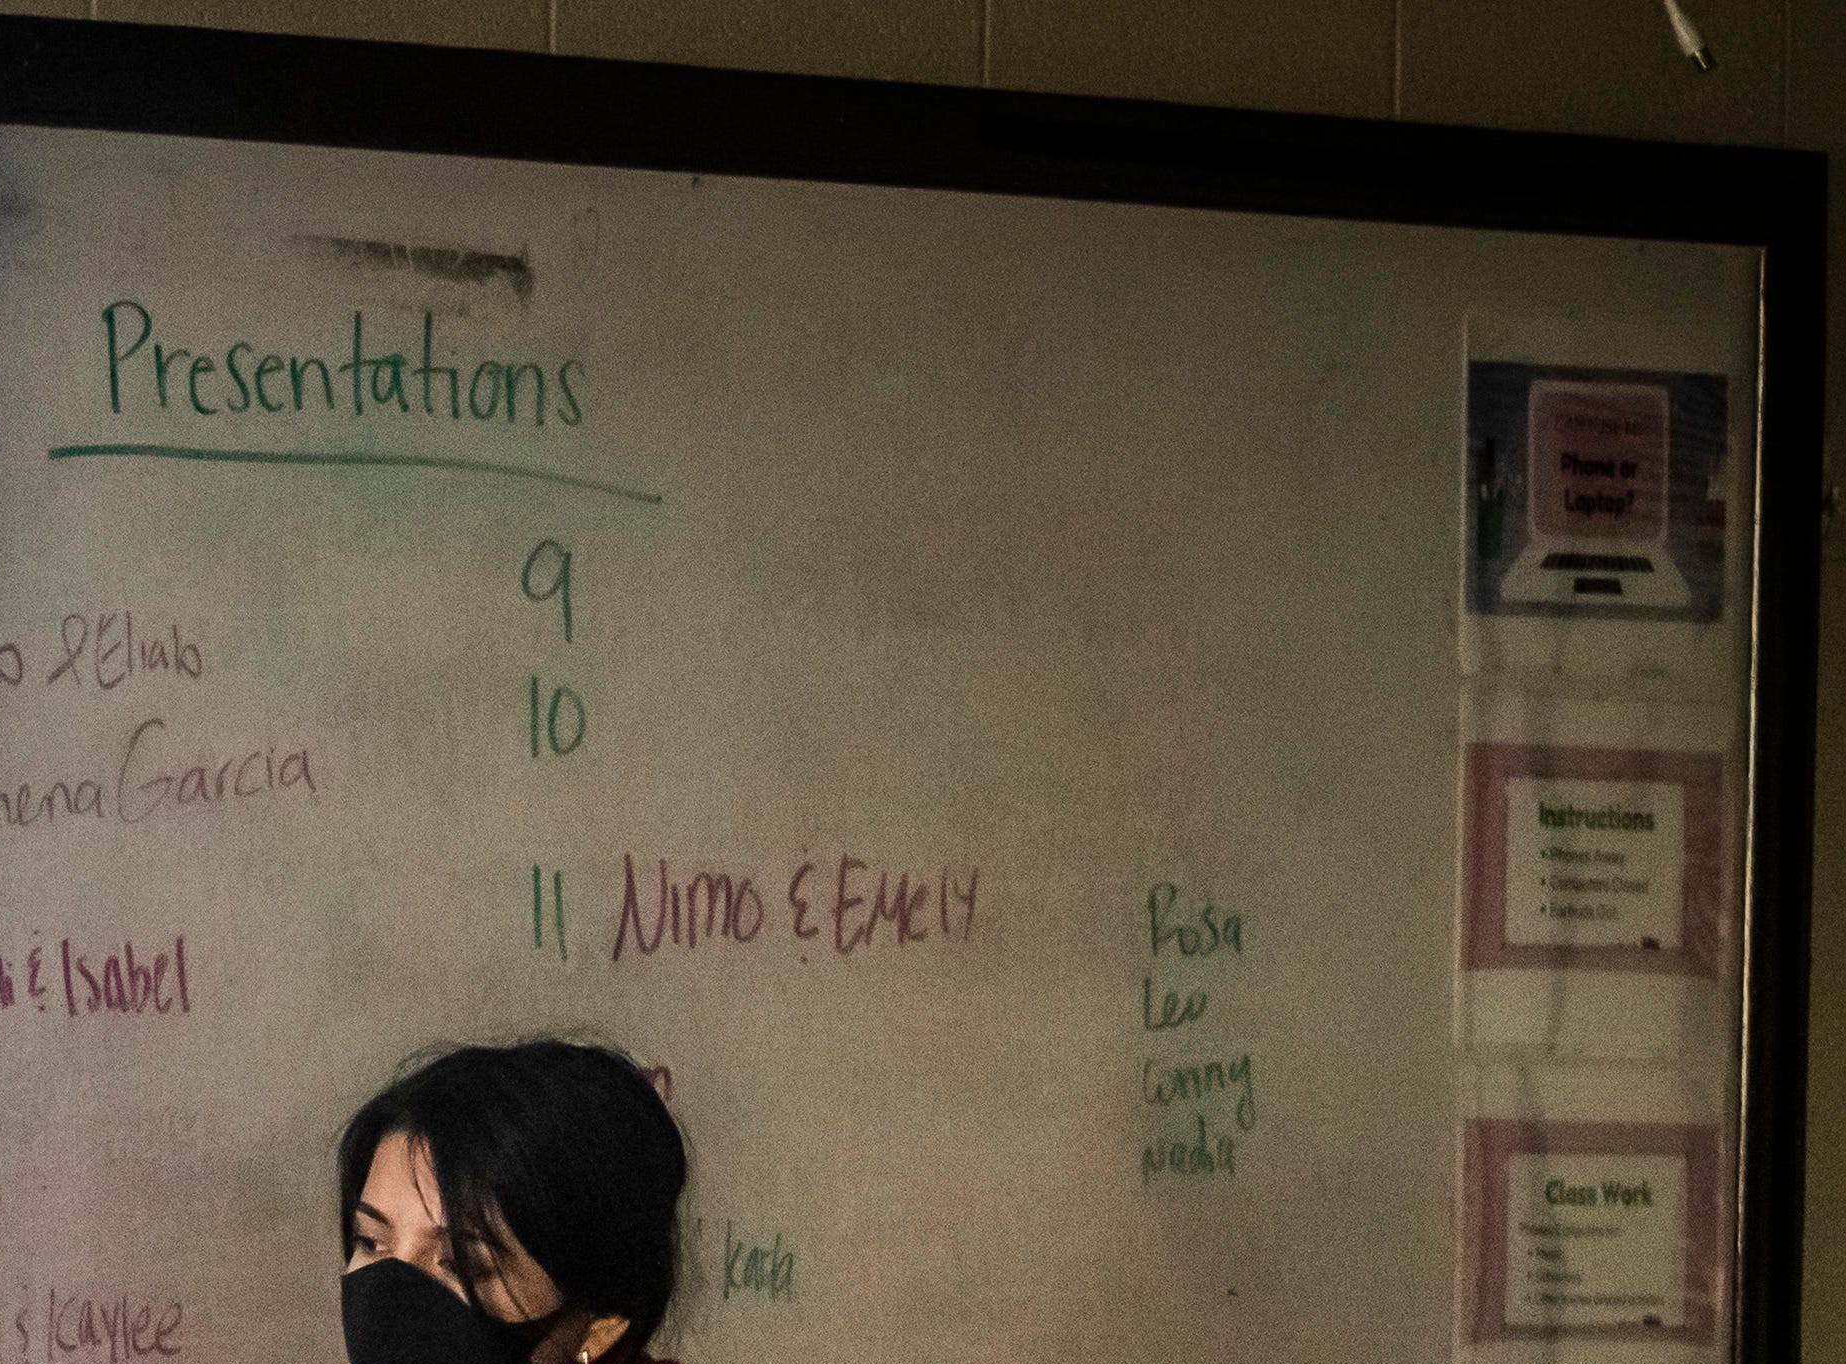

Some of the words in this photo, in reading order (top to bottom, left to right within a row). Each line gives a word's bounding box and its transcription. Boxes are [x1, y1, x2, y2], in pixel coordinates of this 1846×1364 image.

[101, 300, 586, 428] Presentations
[1561, 452, 1615, 478] Phone
[1564, 489, 1634, 518] Laptop?
[520, 538, 573, 643] 9
[529, 676, 586, 758] 10
[117, 717, 318, 825] Garcia
[1539, 801, 1654, 832] Instructions
[532, 864, 567, 962] 11
[61, 935, 190, 1018] Isabel
[1545, 1179, 1596, 1206] Class
[1601, 1180, 1653, 1208] Work
